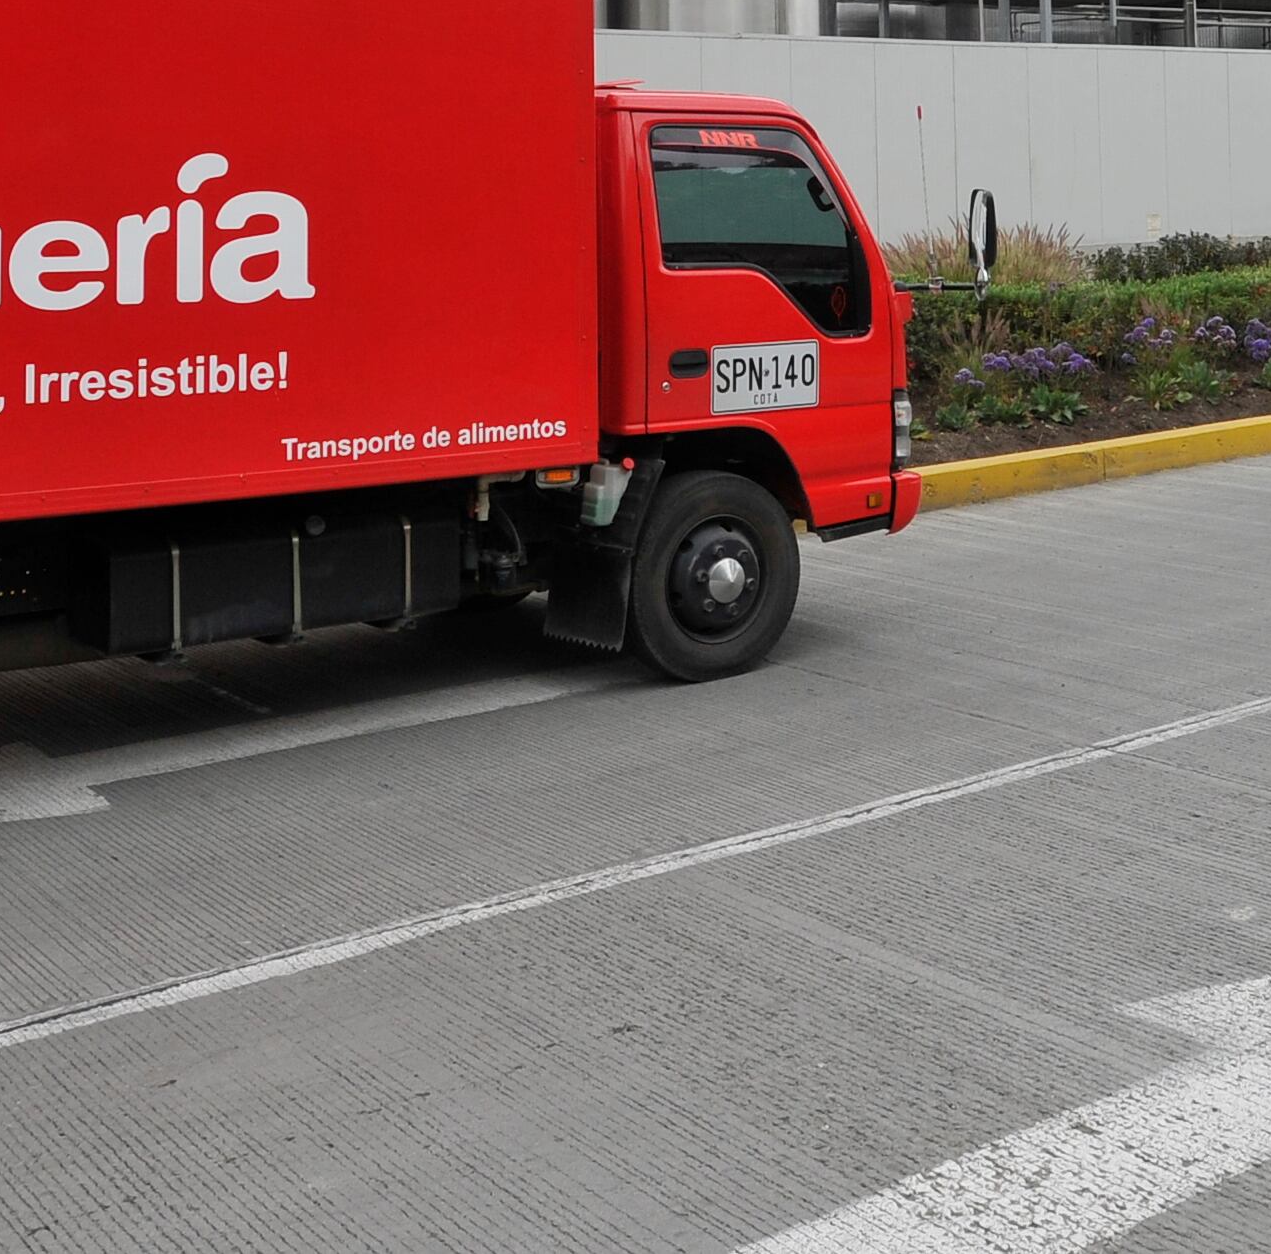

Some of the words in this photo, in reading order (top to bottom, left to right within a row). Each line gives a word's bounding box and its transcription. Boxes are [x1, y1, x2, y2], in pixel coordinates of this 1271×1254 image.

[25, 351, 288, 404] Irresistible!
[753, 393, 778, 405] COTA
[280, 430, 416, 461] Transporte
[422, 426, 451, 449] de
[457, 418, 567, 446] alimentos
